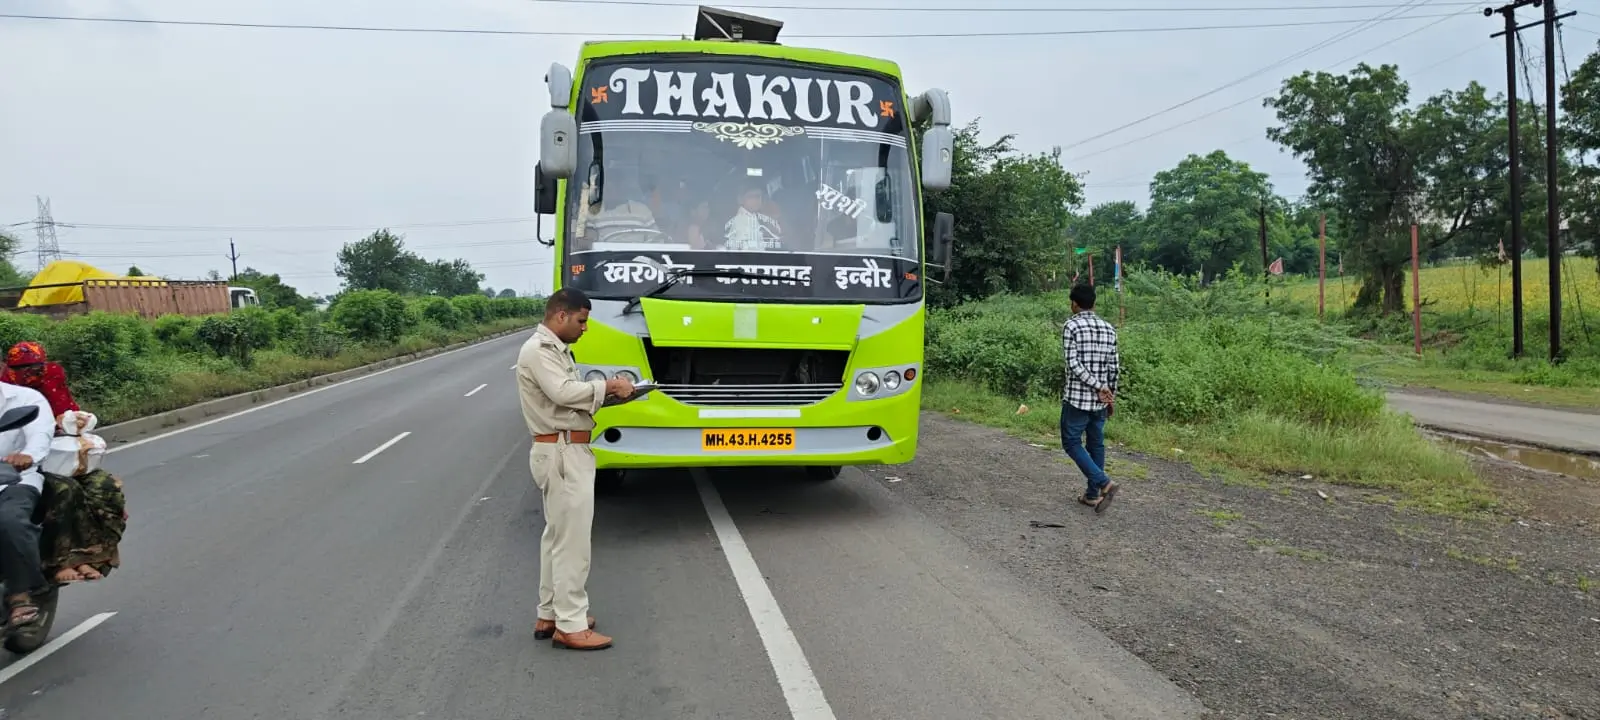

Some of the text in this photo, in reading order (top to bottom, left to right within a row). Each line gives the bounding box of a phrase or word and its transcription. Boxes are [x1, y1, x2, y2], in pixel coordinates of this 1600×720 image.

[609, 67, 879, 128] THAKUR
[834, 258, 892, 290] इन्दौर
[705, 433, 792, 447] MH.43.H.4255
